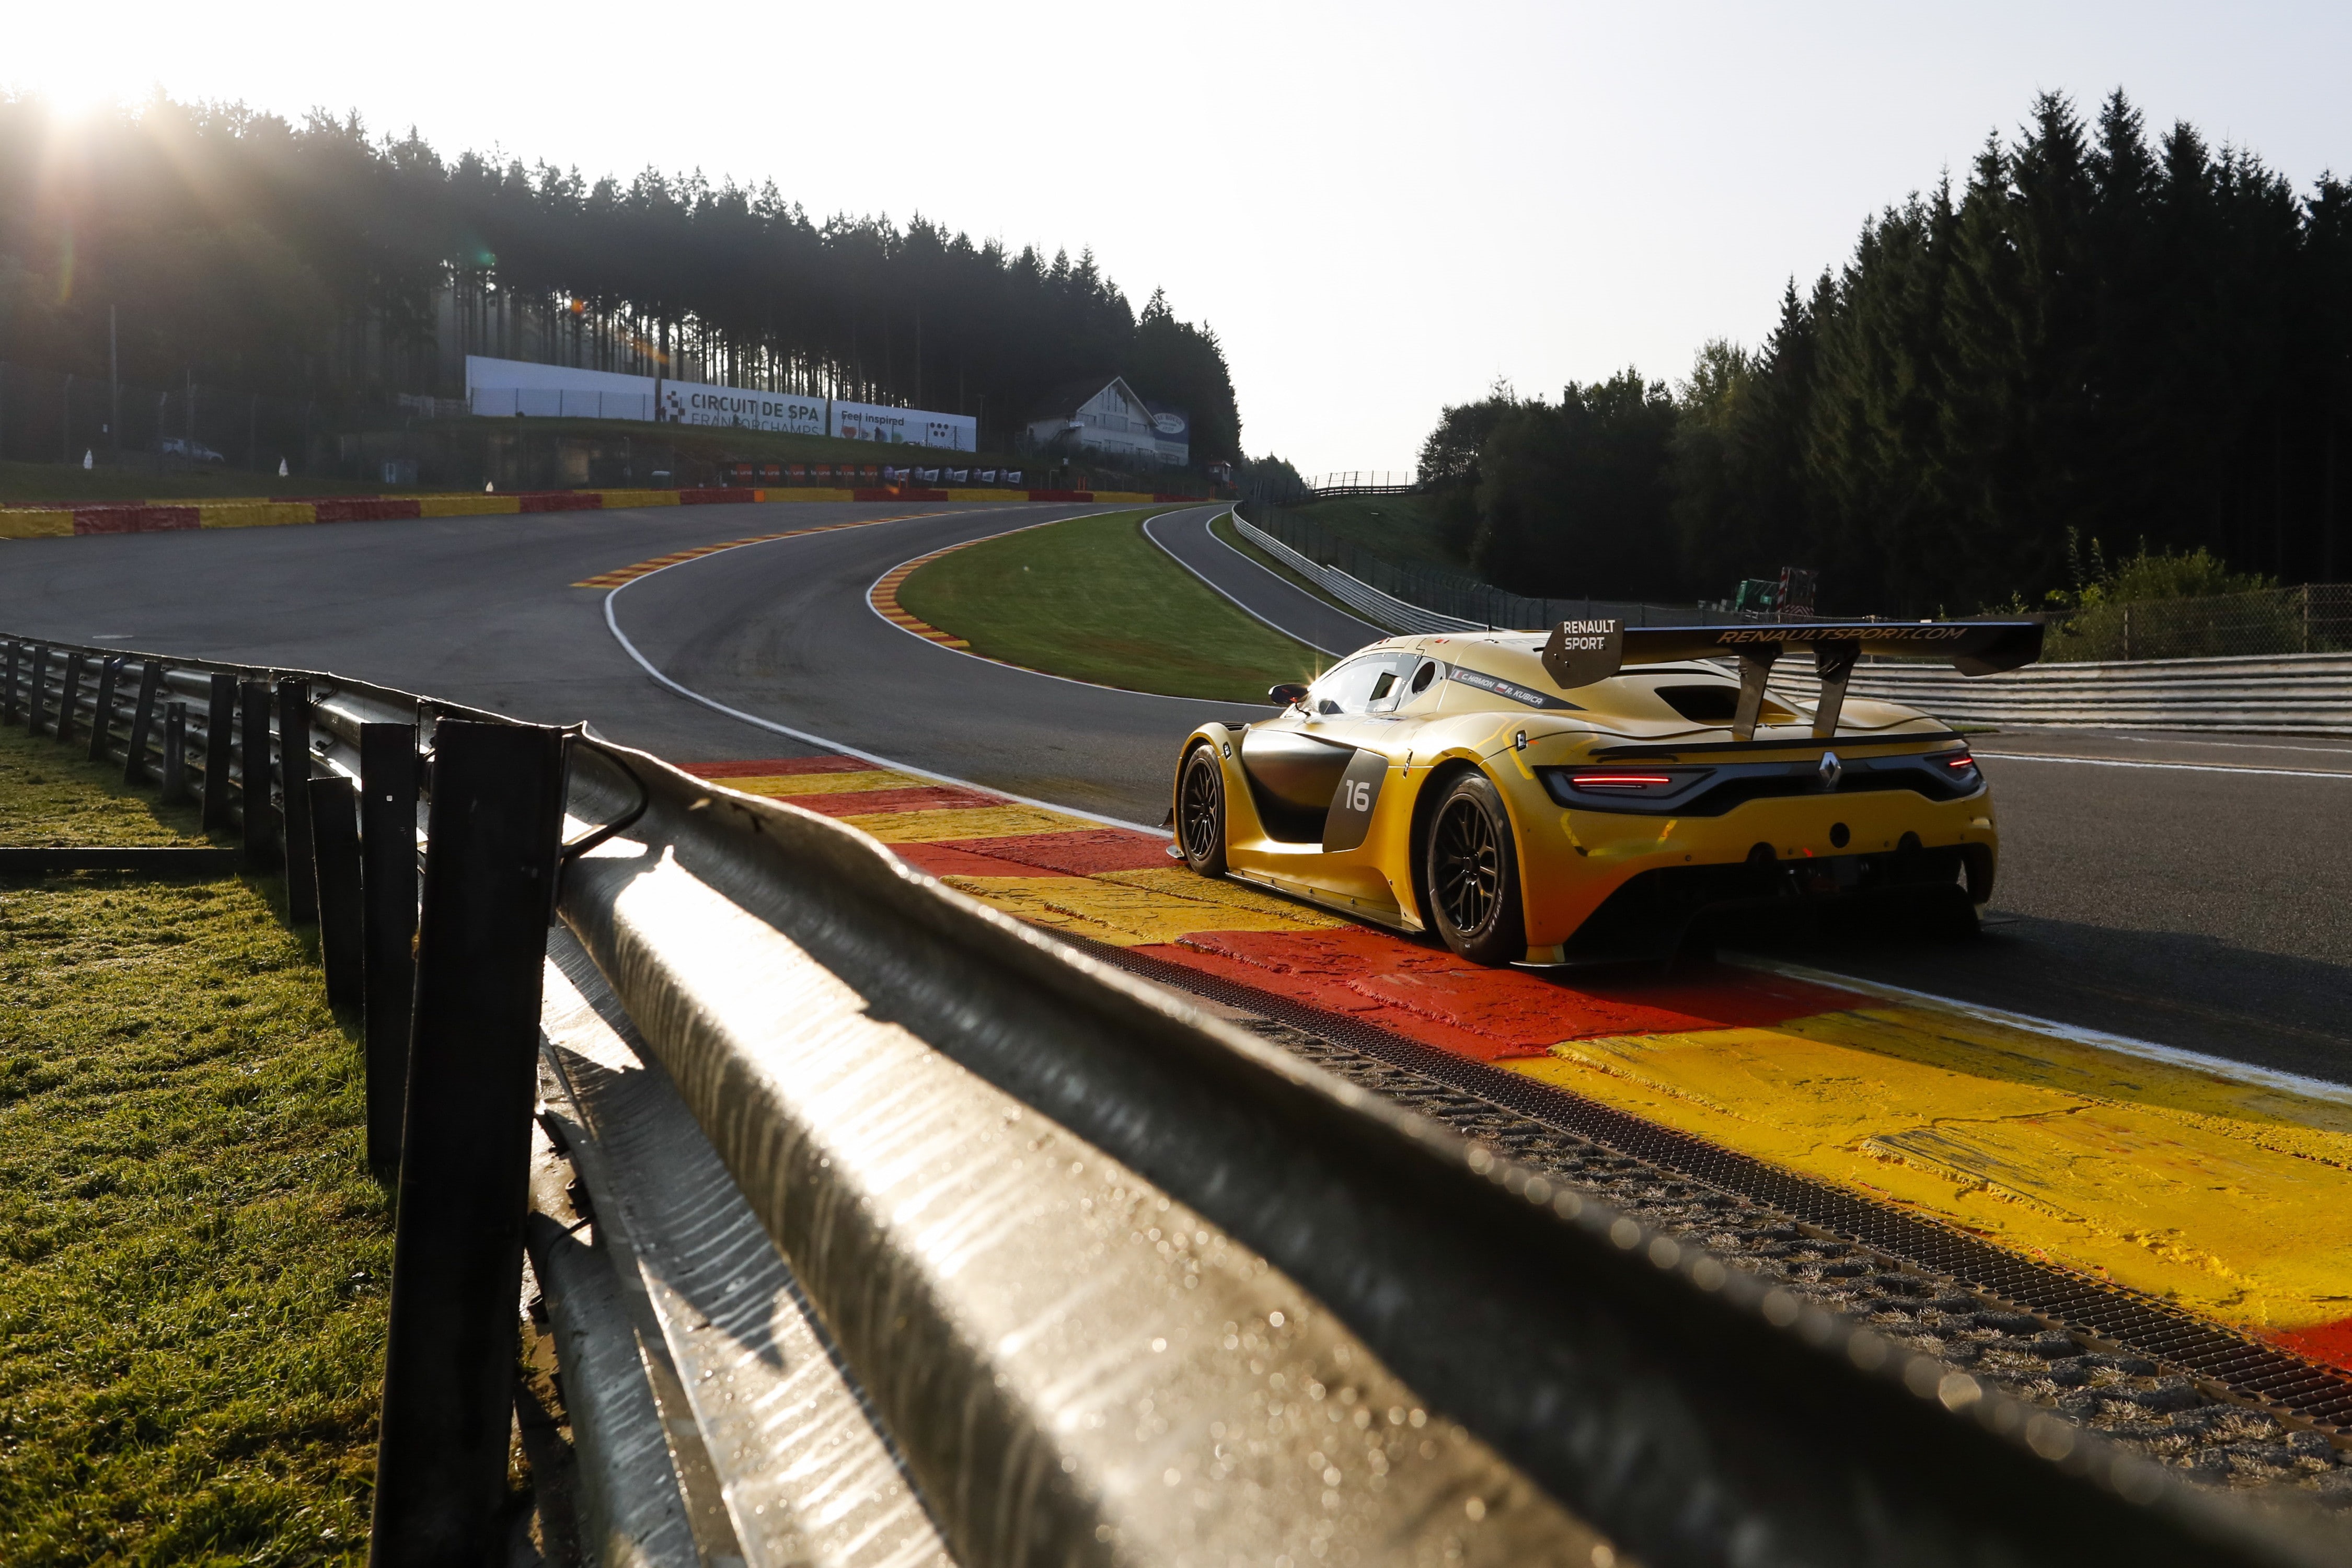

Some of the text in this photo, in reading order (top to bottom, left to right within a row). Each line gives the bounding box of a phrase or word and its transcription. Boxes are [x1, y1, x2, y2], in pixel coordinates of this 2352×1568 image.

[691, 393, 819, 422] CIRCUIT DE SPA
[692, 413, 820, 435] FRANORCHAMPS
[841, 410, 904, 426] Feel inspired
[1563, 619, 1616, 634] RENAULT
[1565, 637, 1605, 650] SPORT
[1716, 628, 1968, 643] RENAULTSPORT.COM
[1505, 687, 1543, 705] R. KUBICA
[1346, 779, 1370, 812] 16
